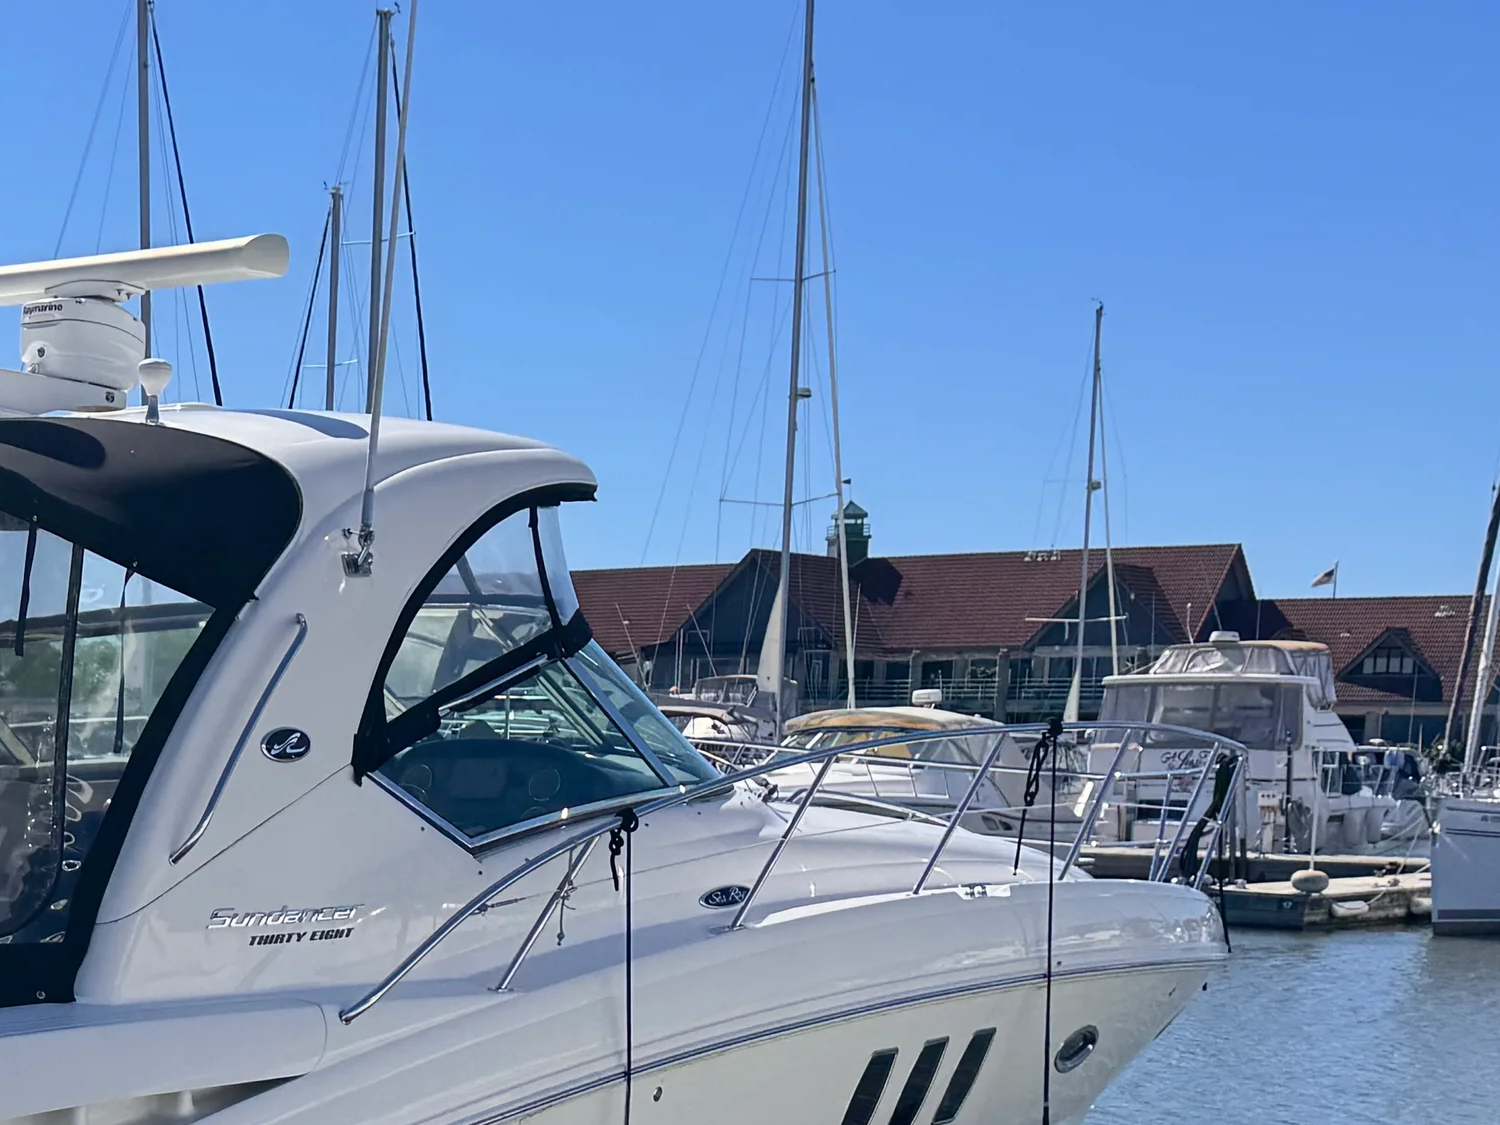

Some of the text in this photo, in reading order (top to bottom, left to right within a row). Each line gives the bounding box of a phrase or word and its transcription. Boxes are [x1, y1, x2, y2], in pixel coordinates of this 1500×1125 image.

[206, 903, 366, 930] Sundancer
[248, 927, 355, 947] THIRTY EIGHT
